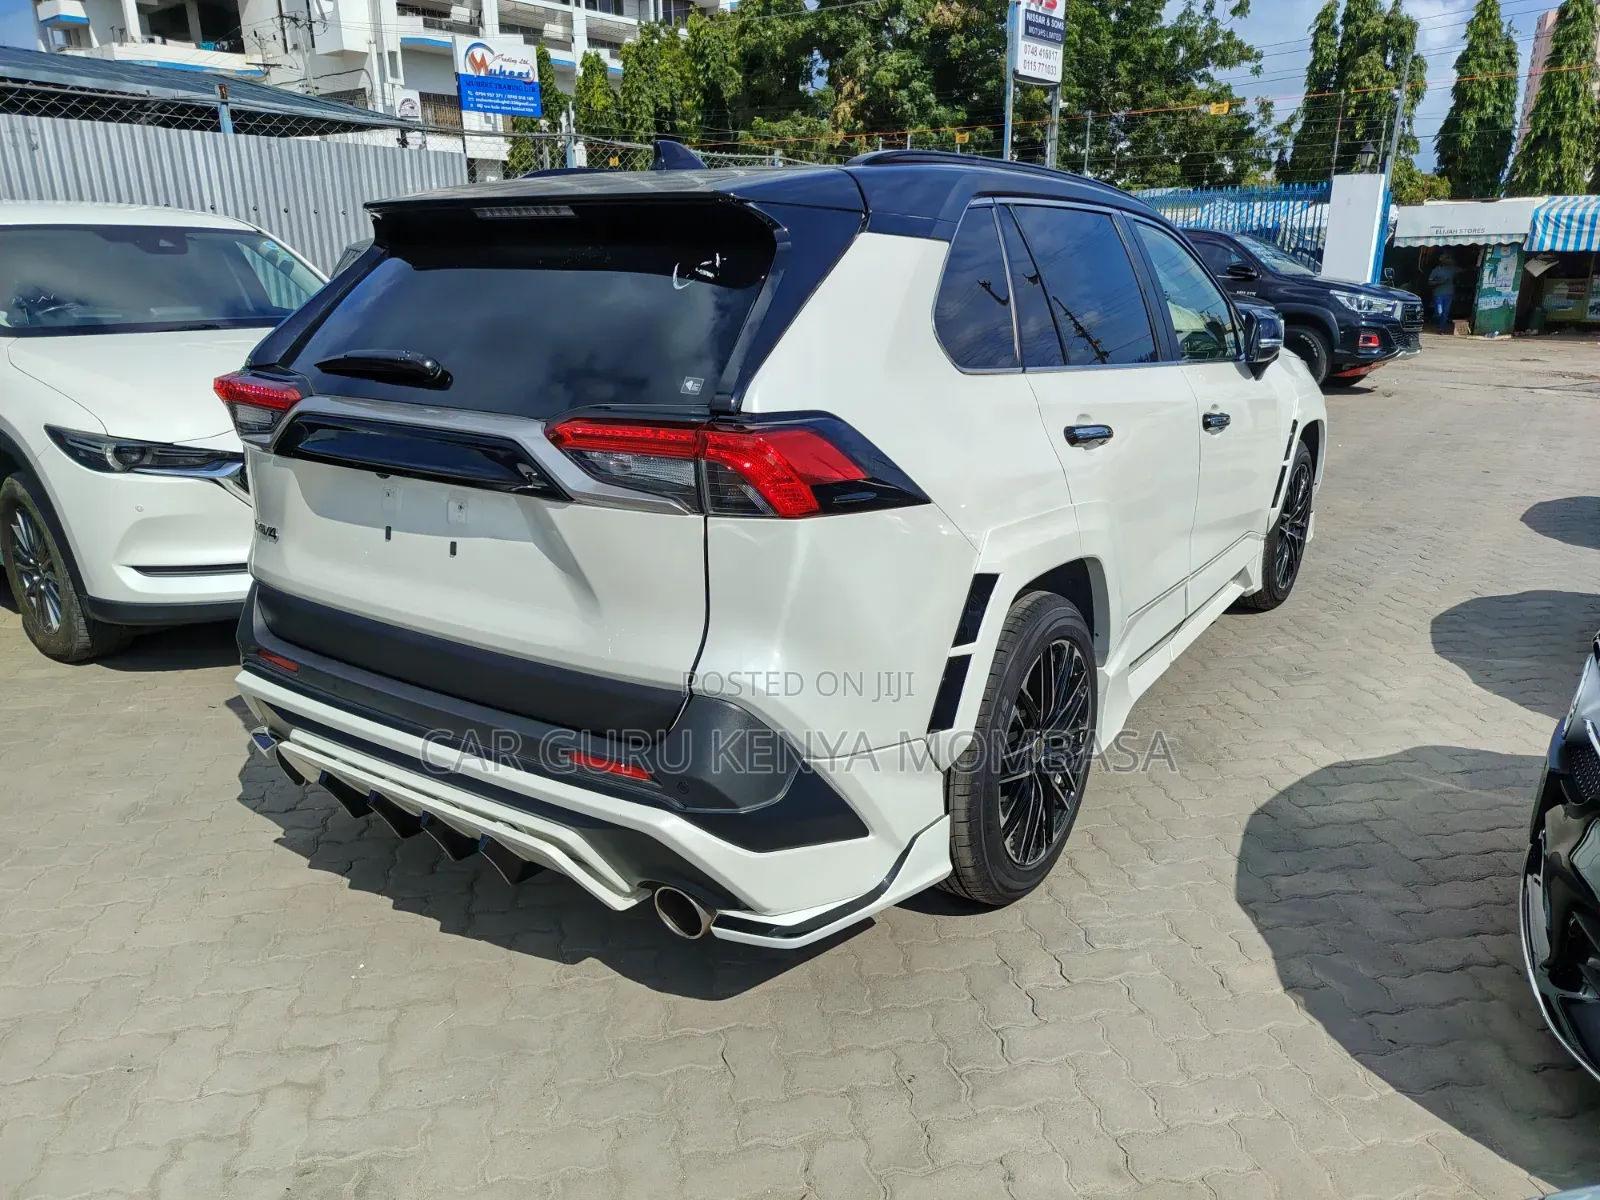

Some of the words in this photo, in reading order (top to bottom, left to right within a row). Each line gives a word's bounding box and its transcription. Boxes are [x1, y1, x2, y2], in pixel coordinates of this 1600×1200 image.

[1026, 11, 1046, 26] NISSAR
[1046, 17, 1051, 27] &
[1051, 19, 1065, 31] SONS
[1028, 25, 1046, 38] MOTORS
[1046, 30, 1062, 42] LIMITED
[1023, 44, 1038, 57] 0748
[1023, 59, 1037, 72] 0115
[465, 80, 493, 89] MUHEET
[493, 82, 523, 92] TRADING
